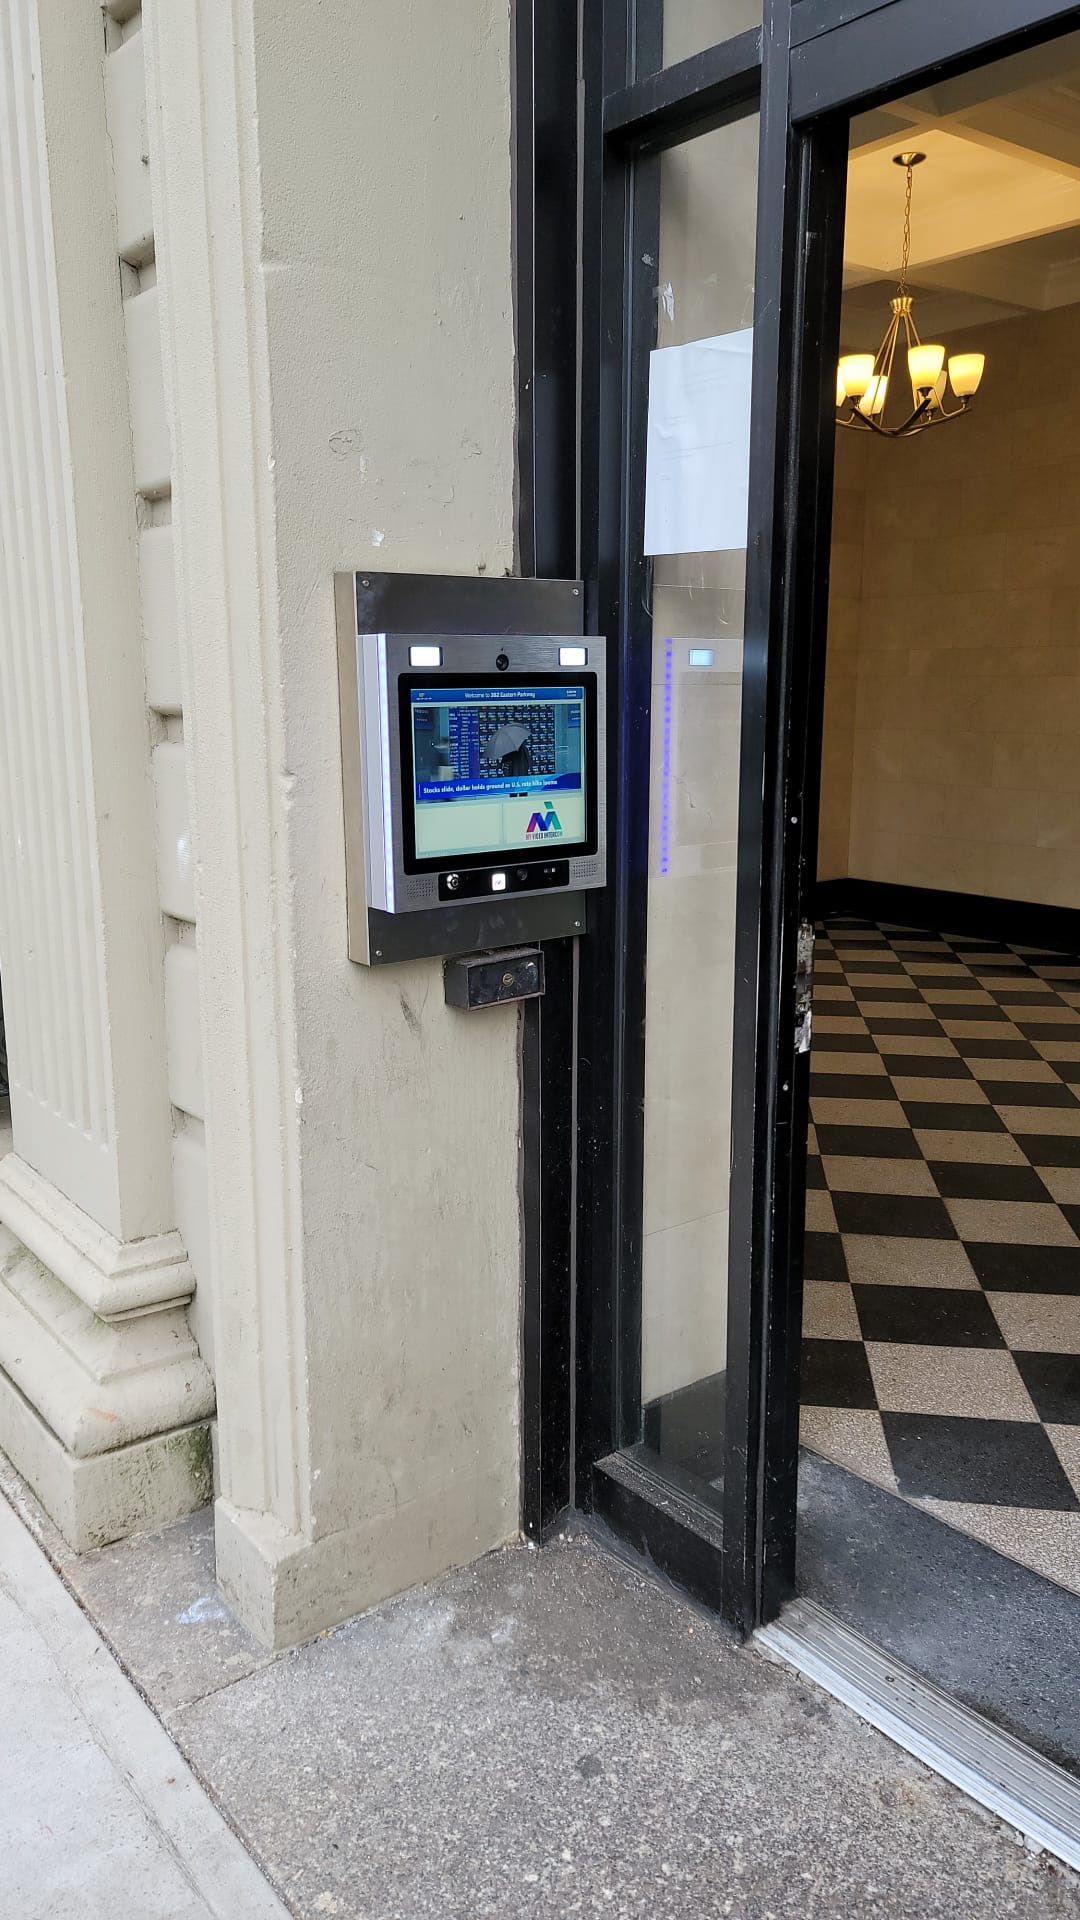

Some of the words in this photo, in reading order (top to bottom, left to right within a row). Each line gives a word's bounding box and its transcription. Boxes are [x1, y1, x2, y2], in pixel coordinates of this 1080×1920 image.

[516, 690, 536, 698] Parkway
[423, 786, 440, 794] Stocks
[441, 785, 455, 793] slide,
[455, 784, 471, 792] dollar
[471, 783, 485, 791] holds
[485, 782, 505, 791] ground
[532, 832, 544, 840] VIDEO
